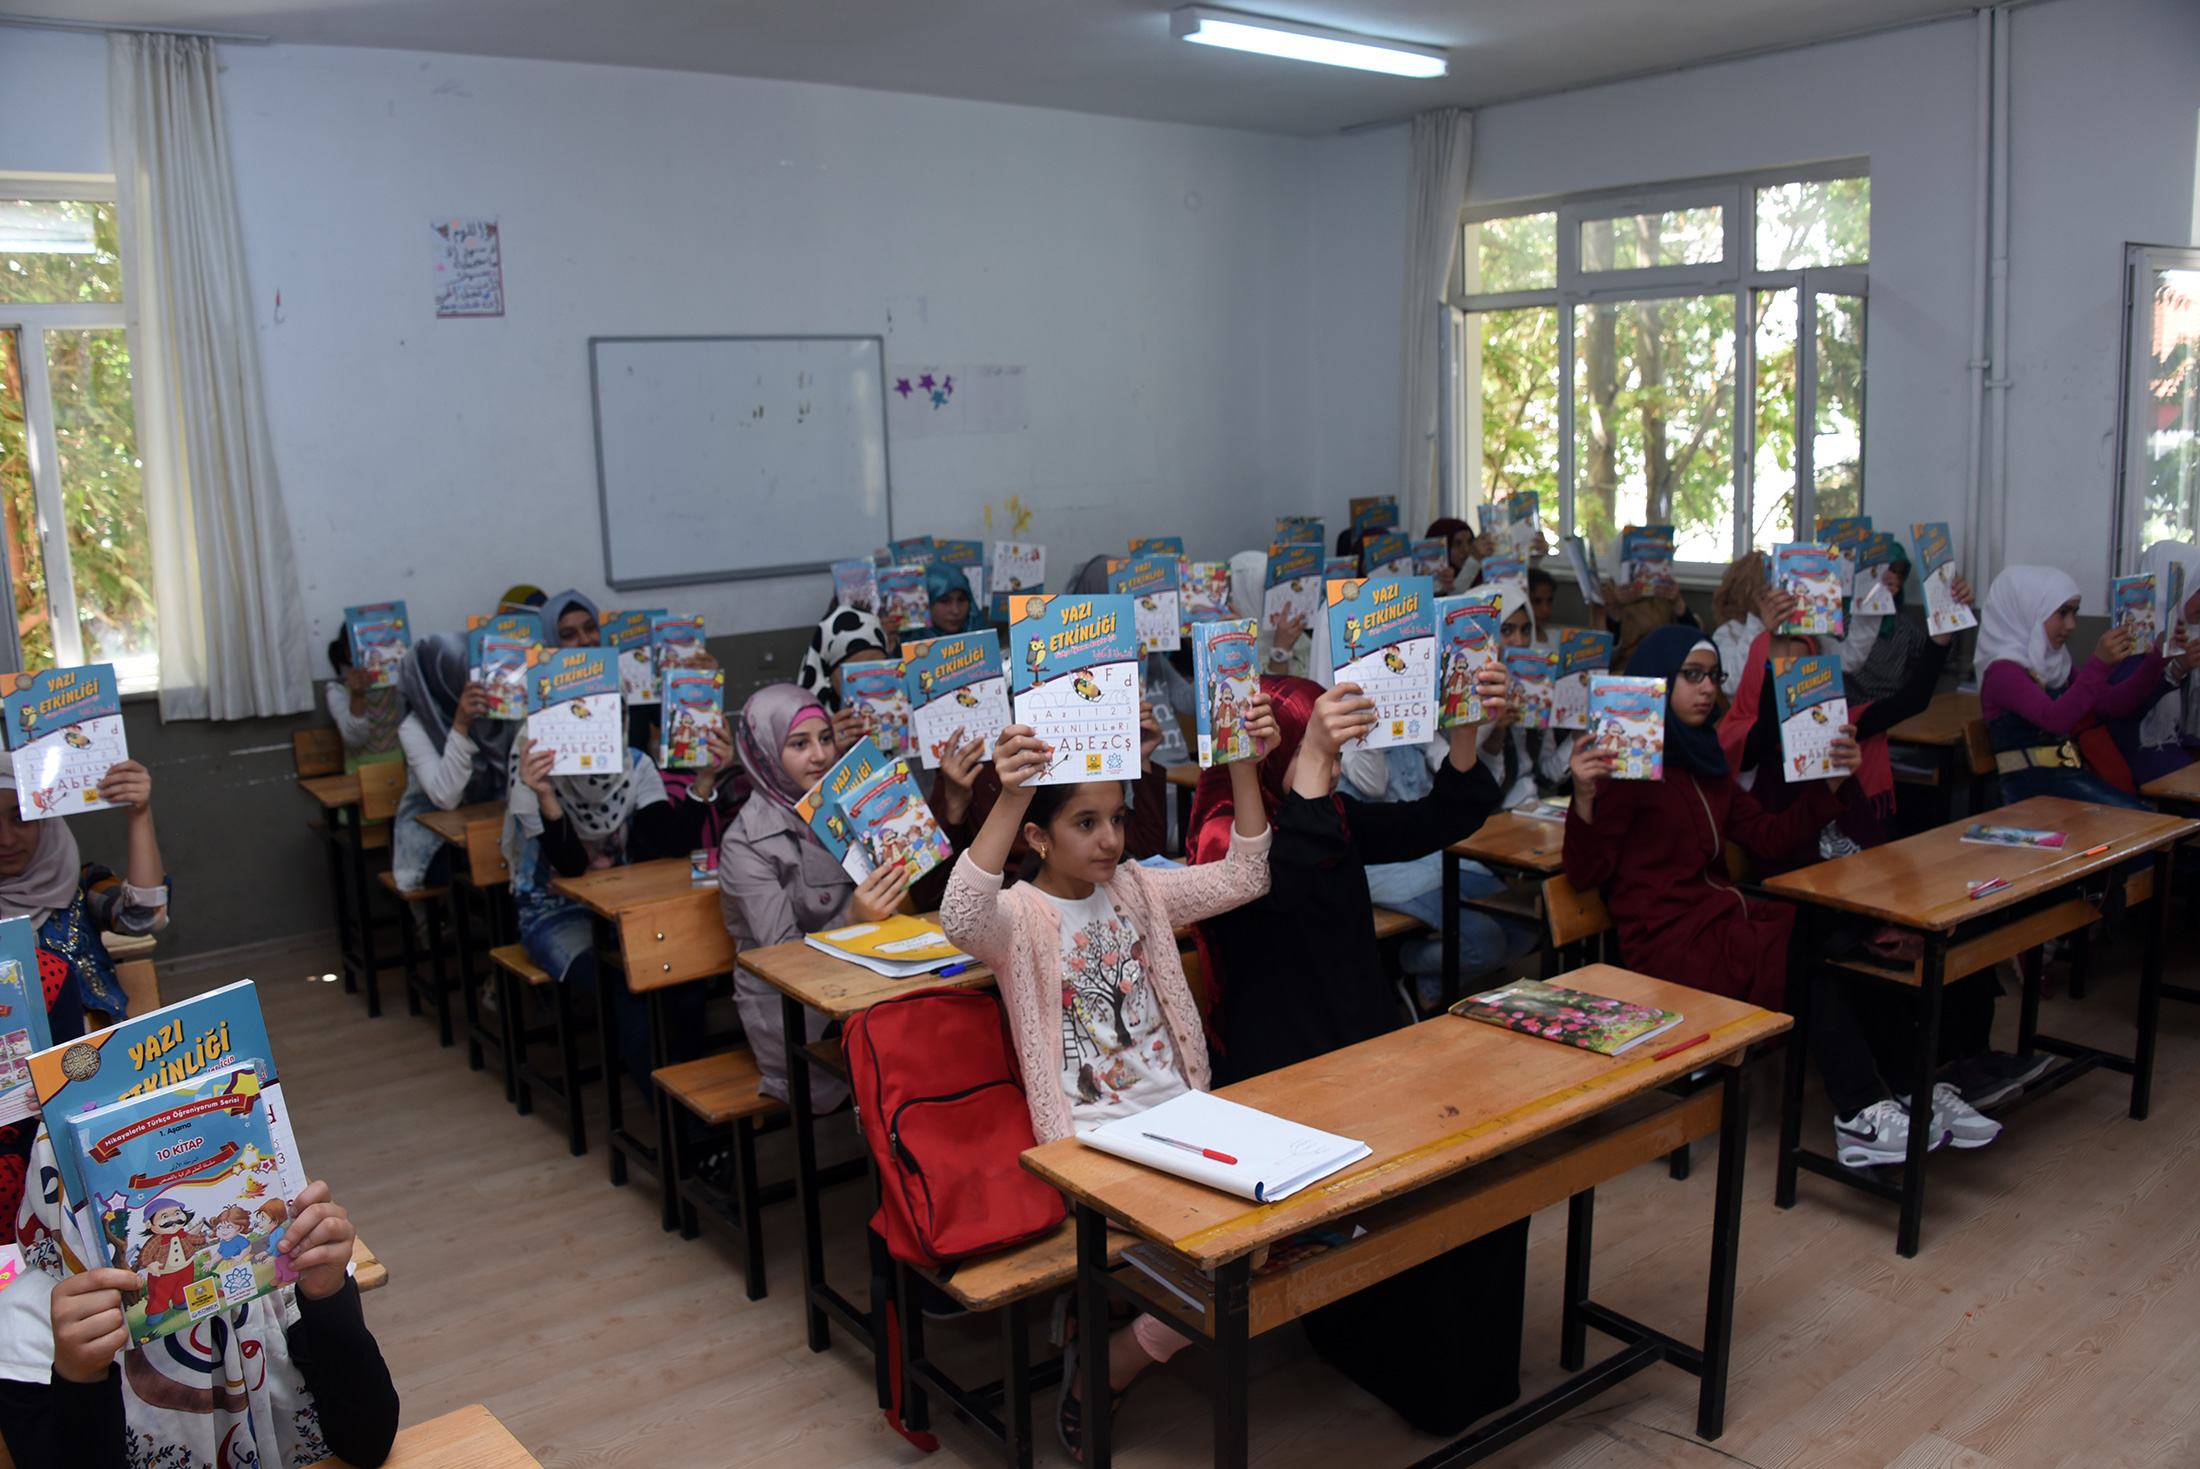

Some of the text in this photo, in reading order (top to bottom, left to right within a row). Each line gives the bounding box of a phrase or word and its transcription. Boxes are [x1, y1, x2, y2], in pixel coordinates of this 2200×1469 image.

[1372, 583, 1399, 606] YAZI
[1060, 600, 1093, 626] YAZI
[1363, 592, 1418, 630] ETKİNLİĞİ
[1049, 611, 1117, 652] ETKİNLİĞİ
[935, 644, 985, 679] ETKİNLİĞİ
[941, 640, 965, 659] YAZI
[47, 672, 76, 693] YAZI
[1105, 668, 1132, 686] F d
[39, 677, 99, 715] ETKİNLİĞİ
[1059, 737, 1071, 752] A
[1075, 737, 1083, 751] b
[1088, 736, 1096, 749] E
[1101, 741, 1108, 750] z
[1111, 734, 1122, 749] C
[831, 765, 852, 795] YAZI
[128, 1019, 183, 1071] YAZI
[104, 1096, 240, 1147] Hikayelerle Türkçe Öğreniyorum Serisi
[159, 1122, 192, 1138] 1. Aşama
[156, 1137, 204, 1161] 10 KİTAP
[278, 1152, 286, 1165] 3
[197, 1302, 219, 1316] KOMEK
